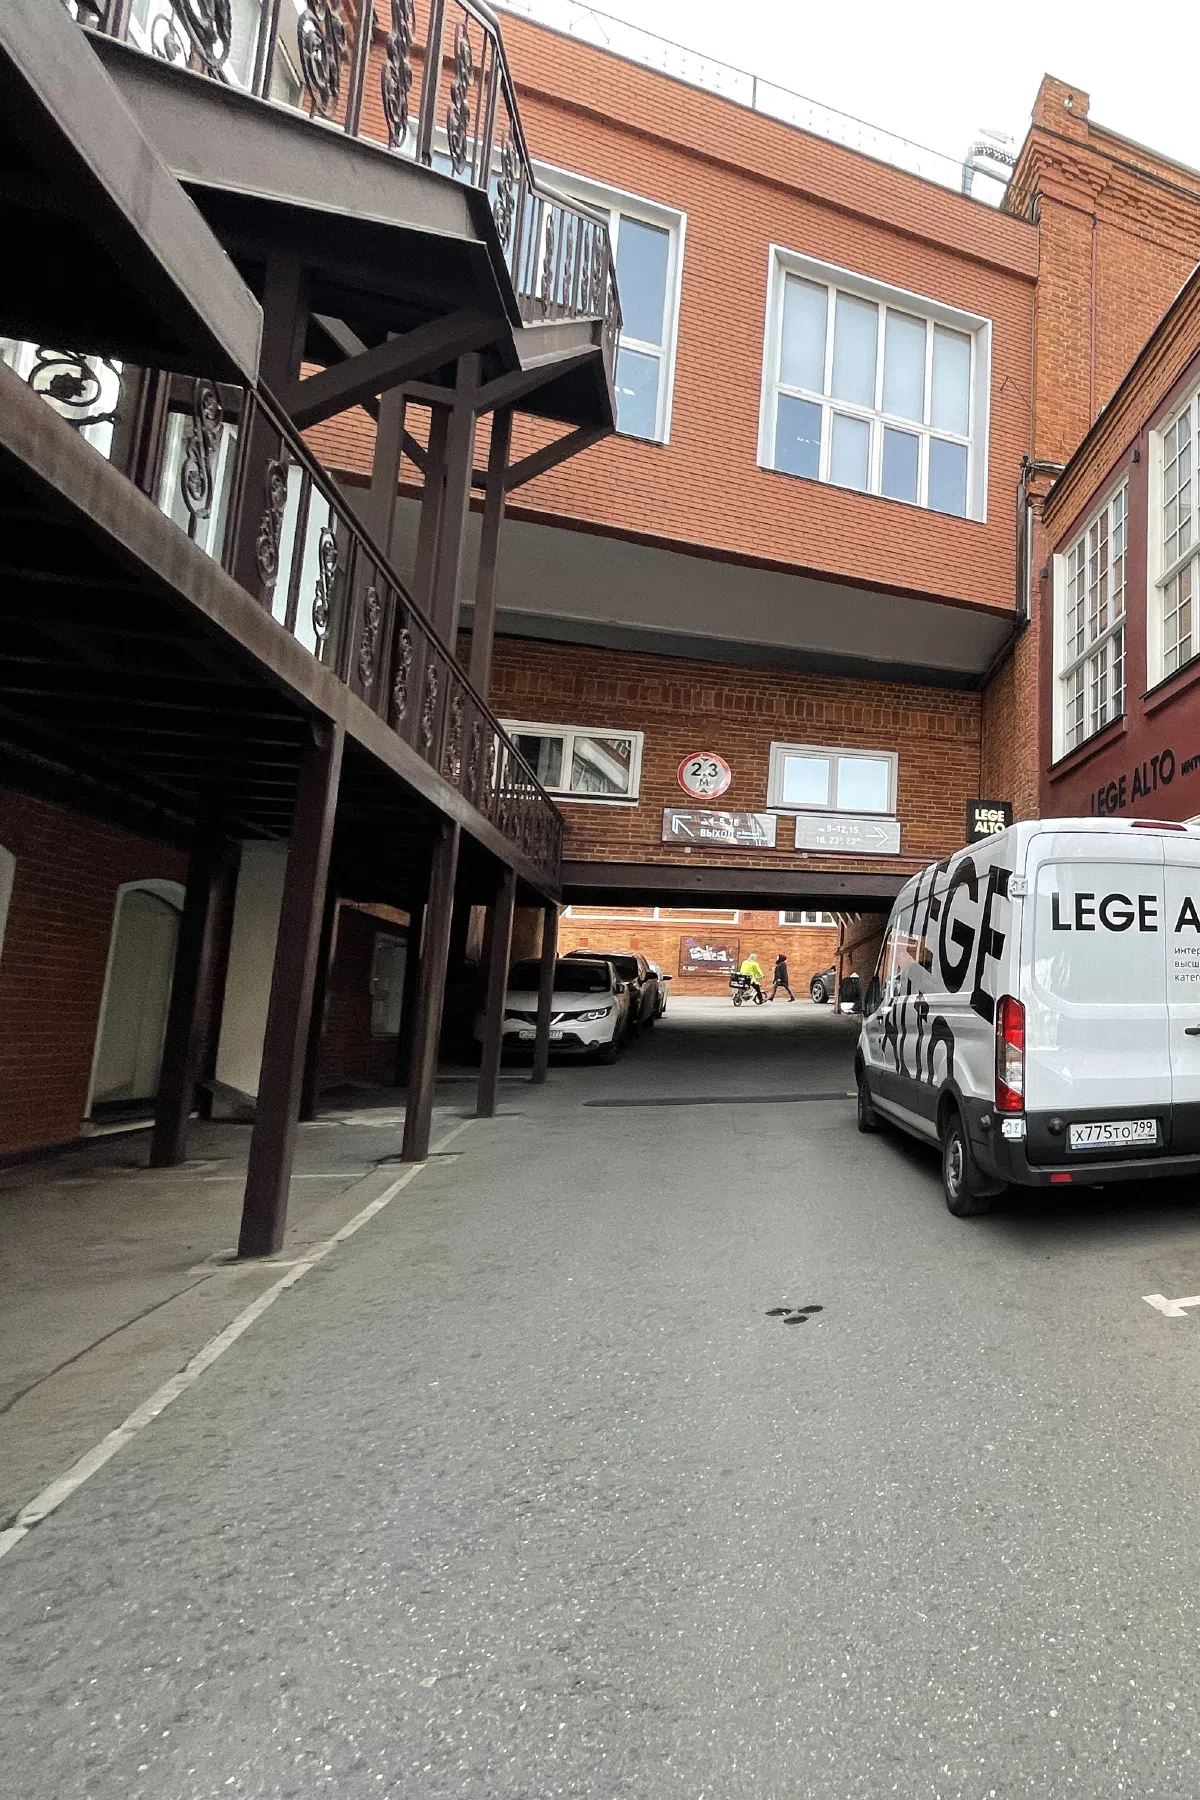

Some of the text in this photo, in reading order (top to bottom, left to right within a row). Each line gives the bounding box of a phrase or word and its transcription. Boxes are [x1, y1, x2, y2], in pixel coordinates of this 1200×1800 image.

[1092, 749, 1175, 816] LEGE ALTO
[975, 809, 1005, 821] LEGE
[700, 828, 734, 839] ВЫХОД
[974, 821, 1006, 833] ALTO
[1052, 892, 1158, 932] LEGE
[908, 855, 1013, 1025] LEGE
[1133, 1121, 1153, 1134] 799
